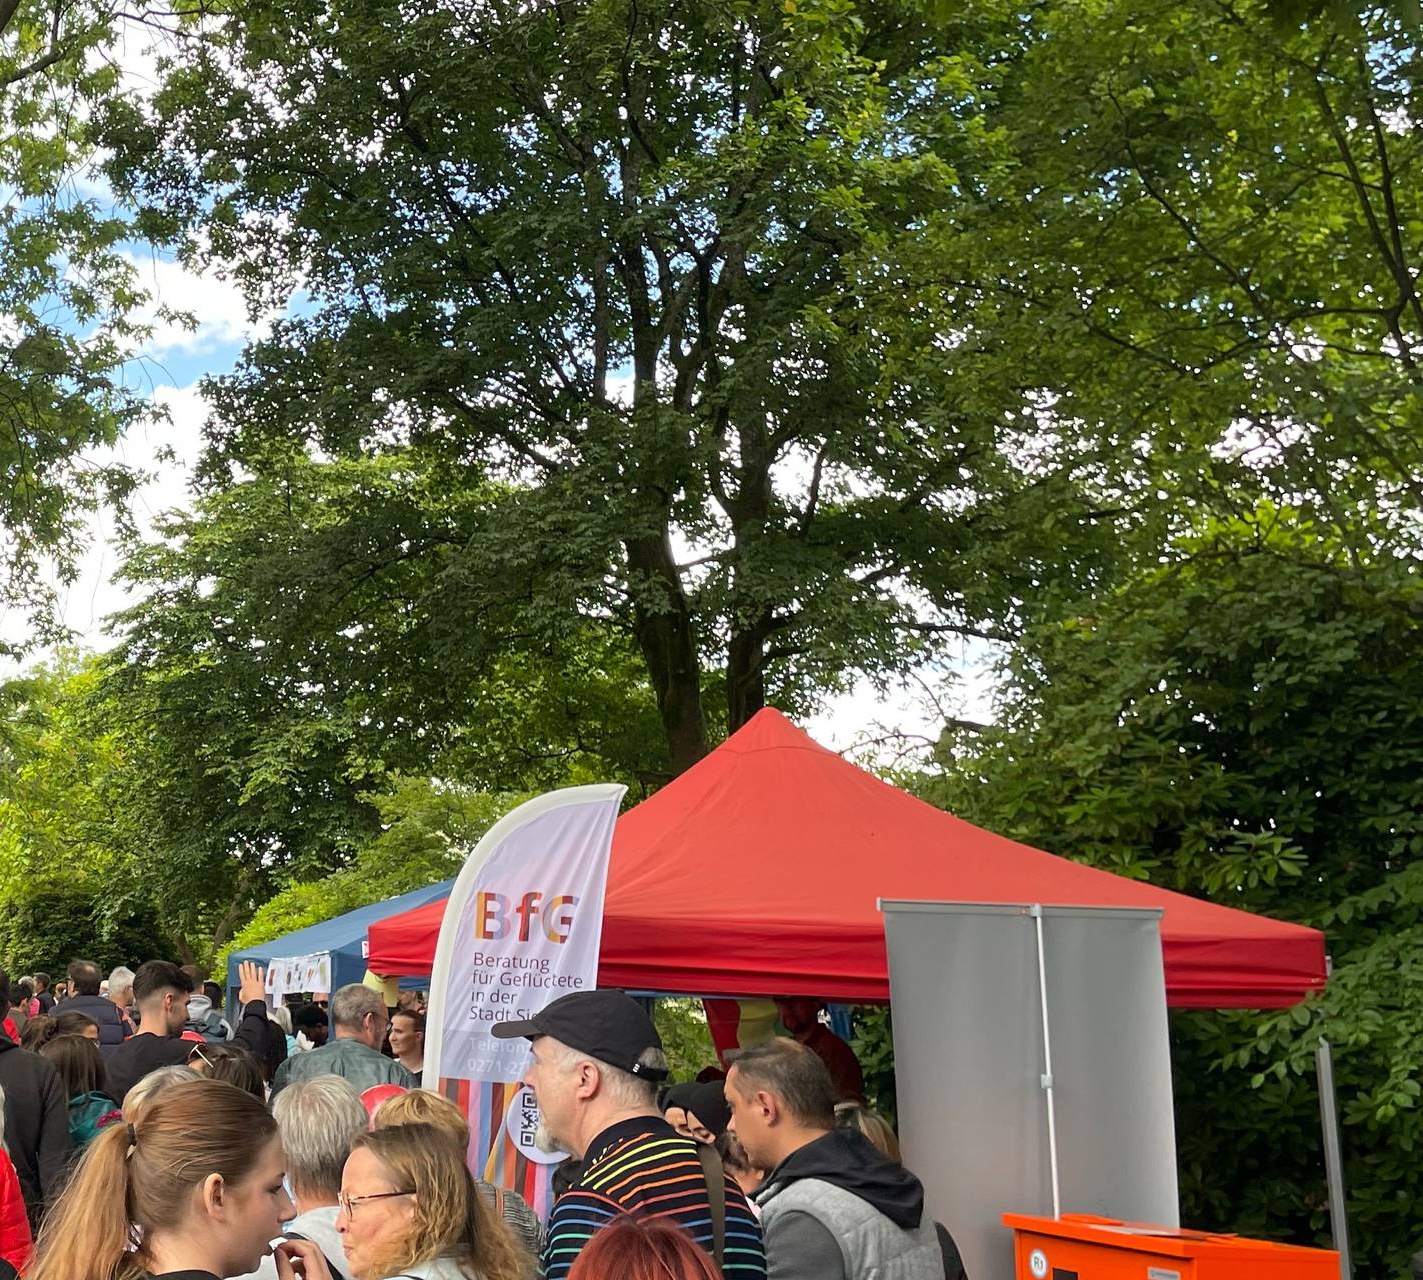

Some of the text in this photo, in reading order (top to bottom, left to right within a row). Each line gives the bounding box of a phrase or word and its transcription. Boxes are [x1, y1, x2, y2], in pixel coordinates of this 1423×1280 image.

[474, 891, 581, 944] BfG
[473, 952, 550, 974] Beratung
[472, 970, 495, 985] für
[471, 989, 518, 1004] in der
[469, 1006, 511, 1022] Stadt
